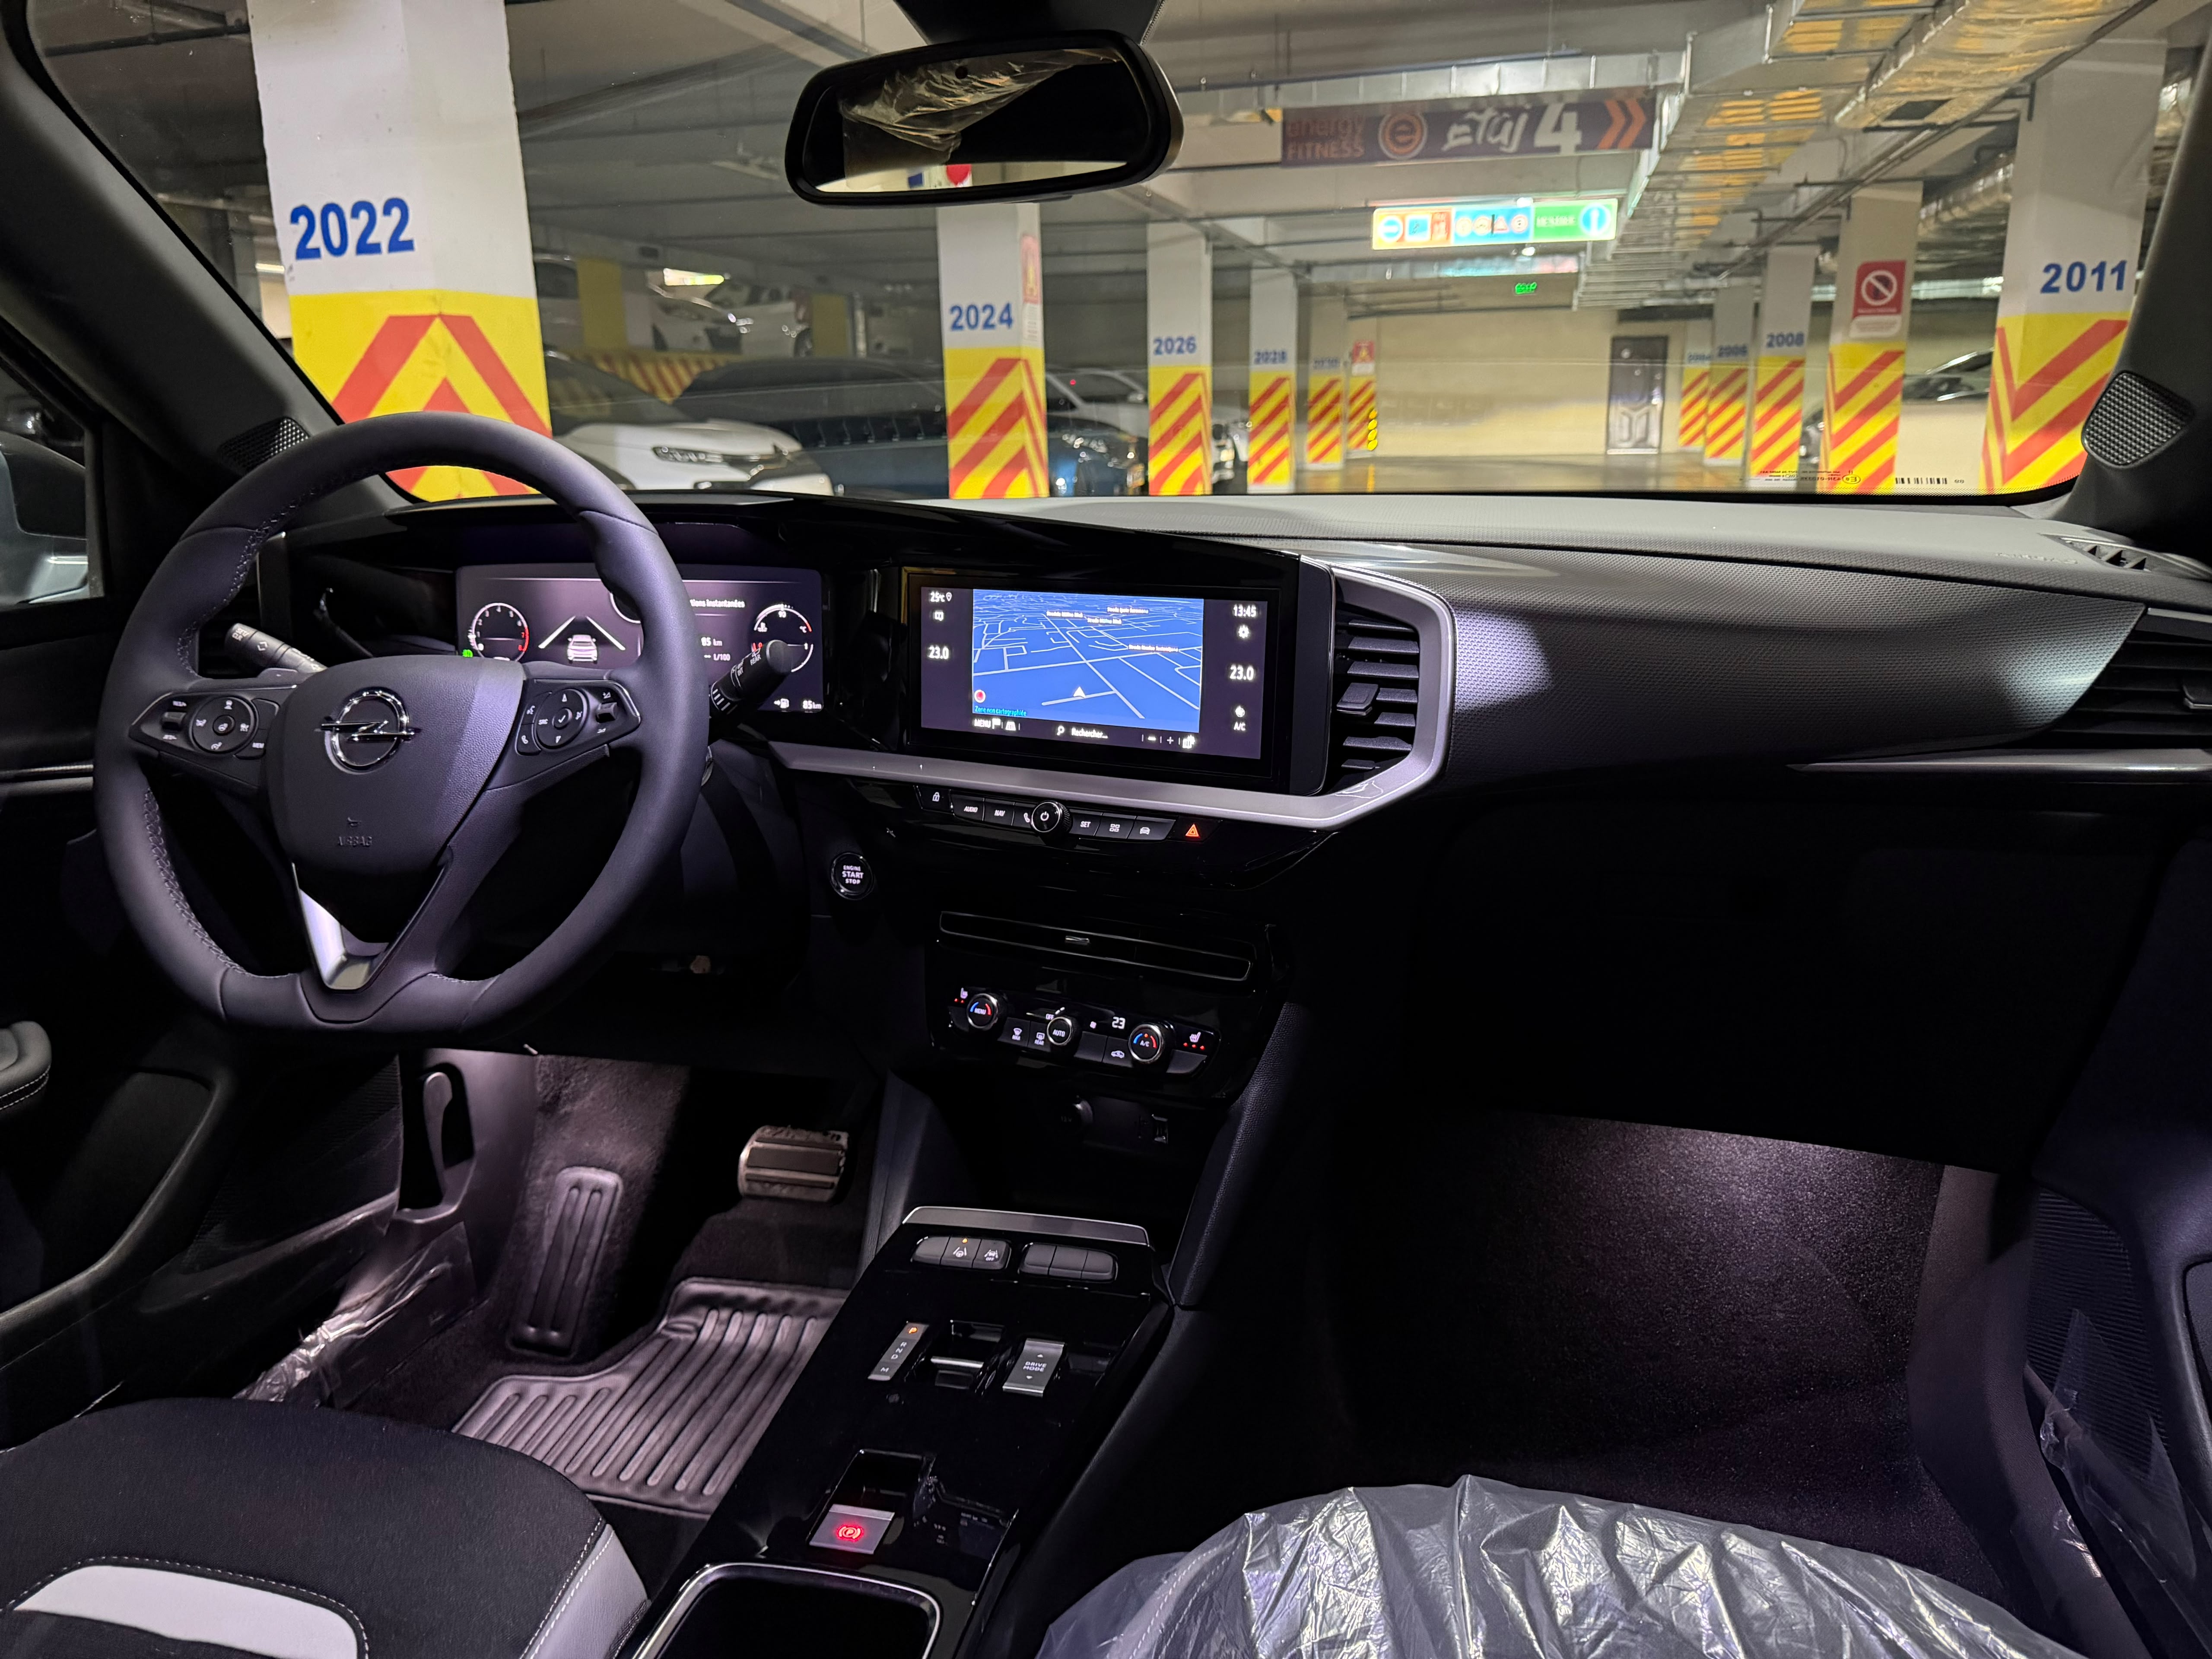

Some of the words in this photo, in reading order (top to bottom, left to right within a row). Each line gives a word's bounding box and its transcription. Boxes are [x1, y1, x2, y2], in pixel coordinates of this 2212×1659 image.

[1535, 102, 1582, 154] 4
[290, 197, 414, 260] 2022
[2040, 259, 2127, 294] 2011
[950, 302, 1013, 331] 2024
[1154, 336, 1197, 355] 2026
[1766, 331, 1805, 348] 2008
[1233, 605, 1256, 617] 13:45
[701, 637, 712, 646] 85
[928, 645, 949, 659] 23.0
[750, 654, 761, 665] REAR
[1230, 665, 1254, 680] 23.0
[974, 718, 991, 728] MENU
[1233, 721, 1246, 731] A/C
[338, 836, 372, 846] AIRBAG
[842, 870, 864, 879] START
[1112, 1016, 1126, 1030] 23
[1052, 1029, 1066, 1037] AUTO
[1140, 1039, 1150, 1048] A/C
